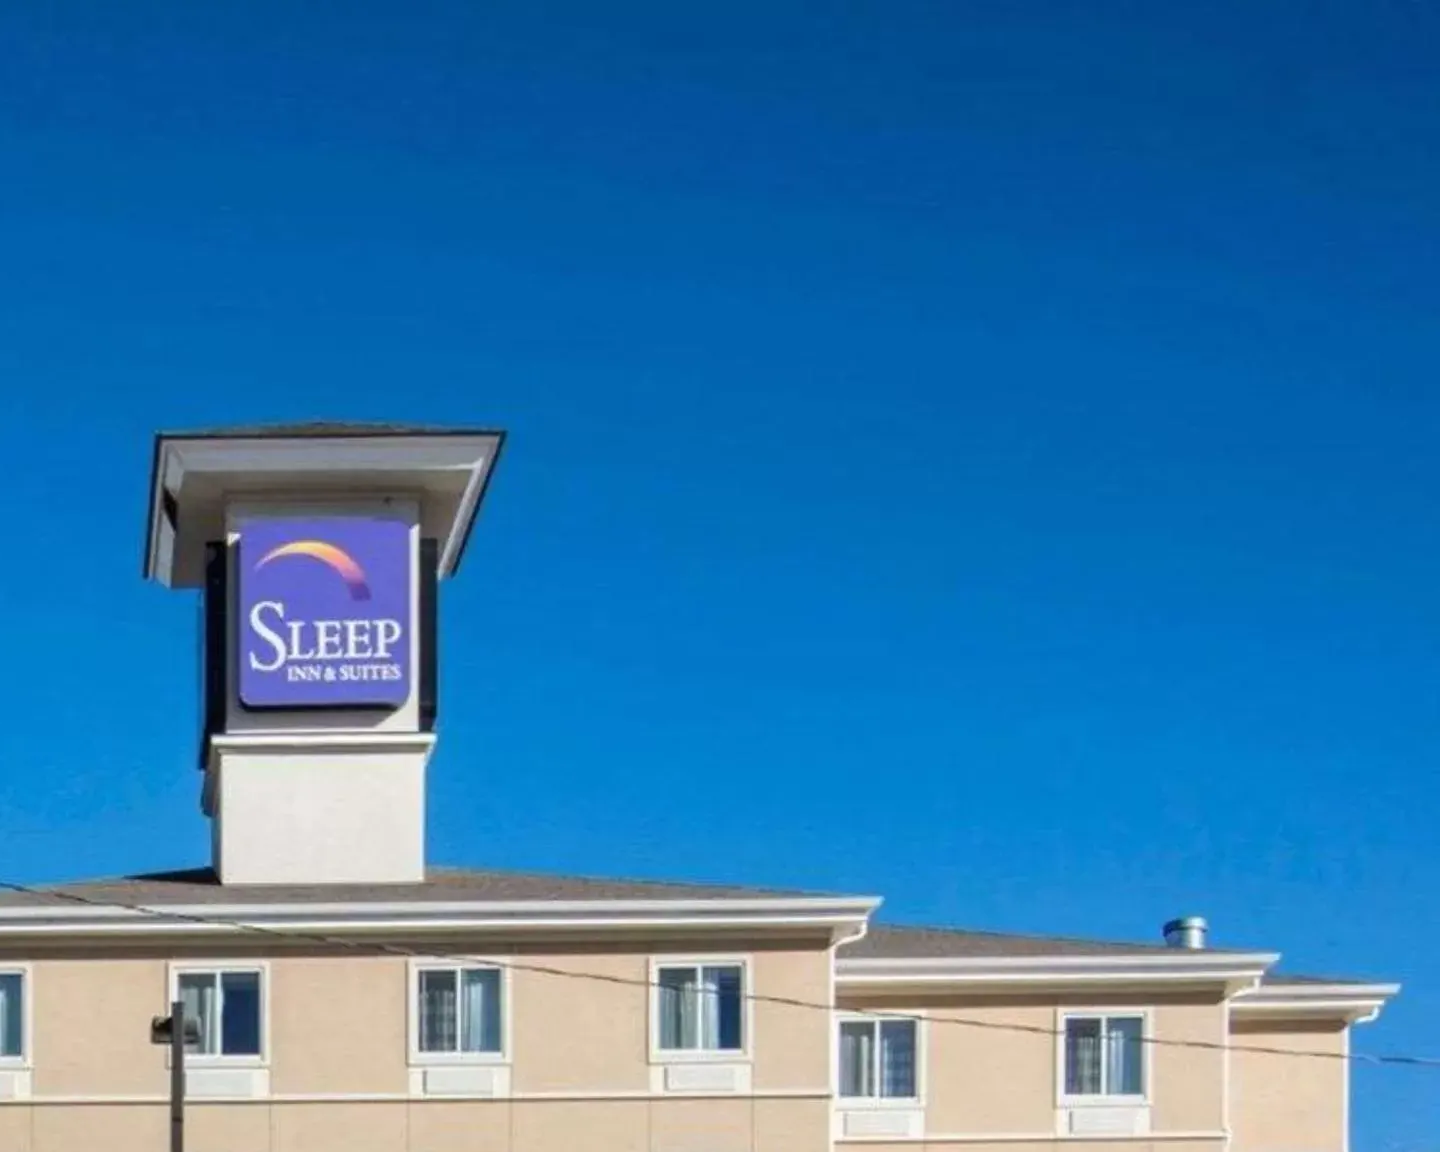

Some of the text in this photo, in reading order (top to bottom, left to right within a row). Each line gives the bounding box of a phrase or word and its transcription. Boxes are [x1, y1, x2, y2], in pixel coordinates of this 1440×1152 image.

[249, 601, 401, 671] SLEEP
[288, 664, 402, 682] INN & SUITES
